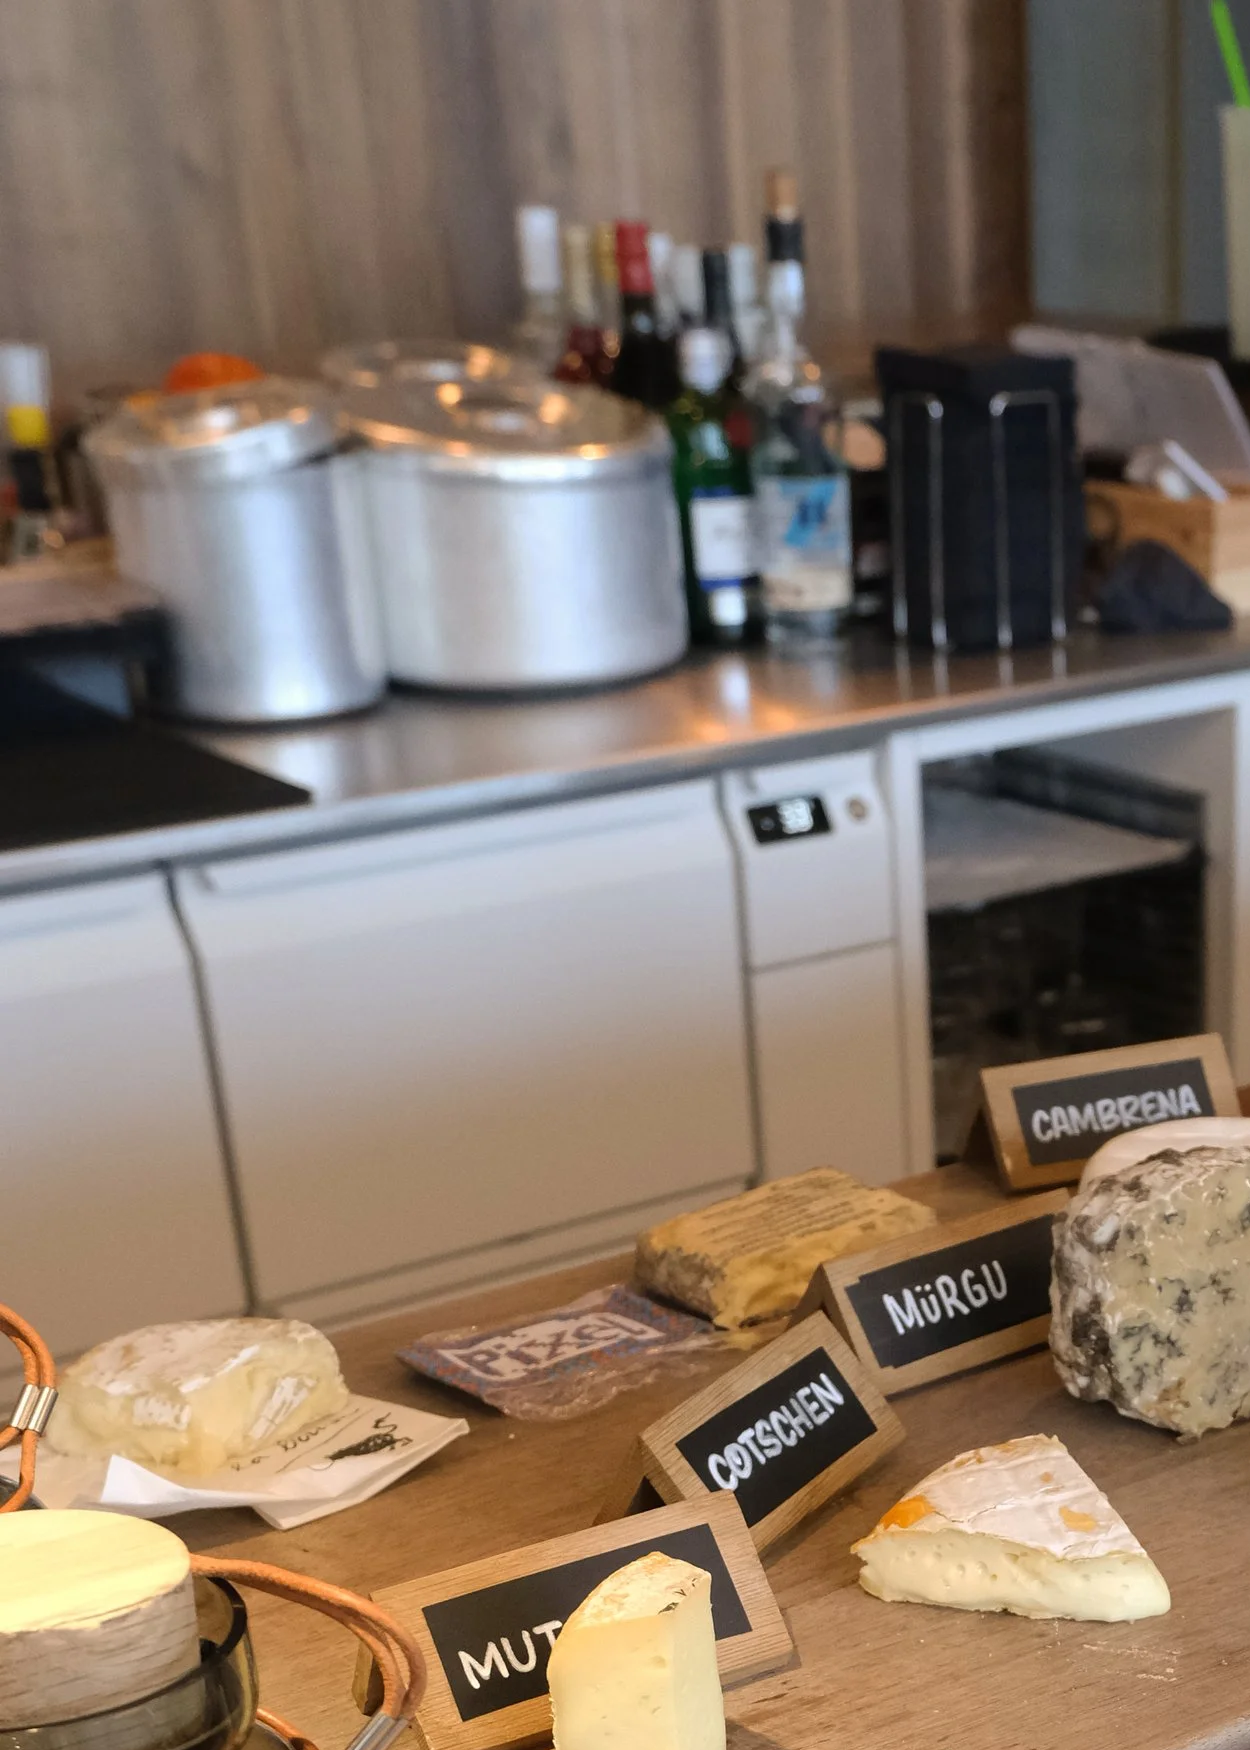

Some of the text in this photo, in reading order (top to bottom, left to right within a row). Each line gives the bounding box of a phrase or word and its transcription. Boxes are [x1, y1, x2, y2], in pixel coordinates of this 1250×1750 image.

[1031, 1084, 1202, 1143] CAMBRENA
[707, 1372, 845, 1491] COTSCHEN
[457, 1620, 563, 1689] MUT
